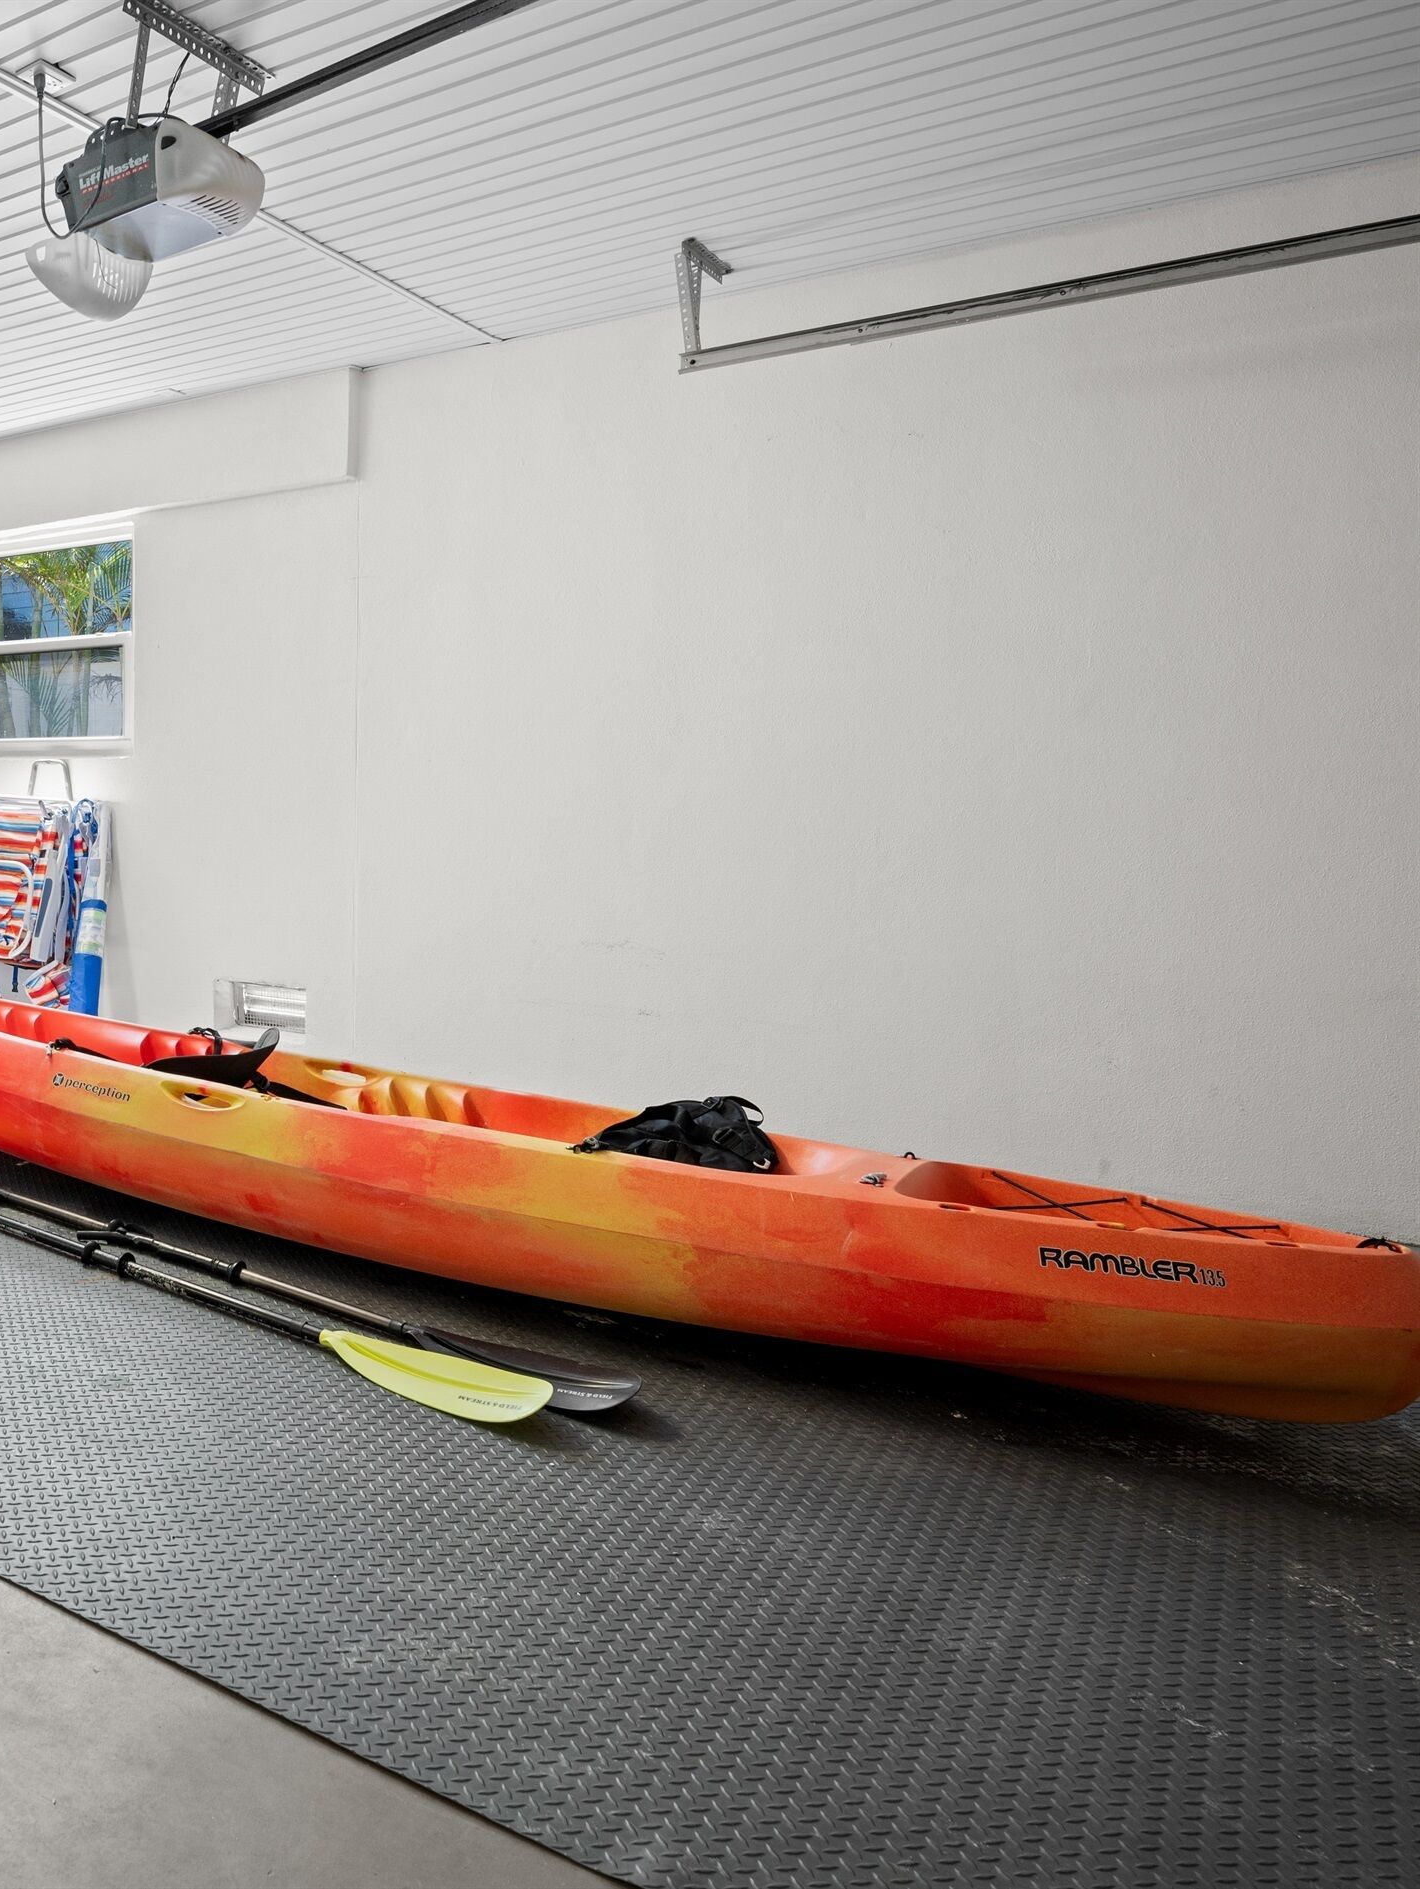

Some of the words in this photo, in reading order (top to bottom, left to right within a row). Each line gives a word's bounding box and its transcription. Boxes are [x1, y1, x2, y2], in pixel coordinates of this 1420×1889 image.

[81, 164, 149, 194] PROESSIONAL
[64, 1078, 131, 1102] perception
[1039, 1246, 1200, 1284] RAMBLER
